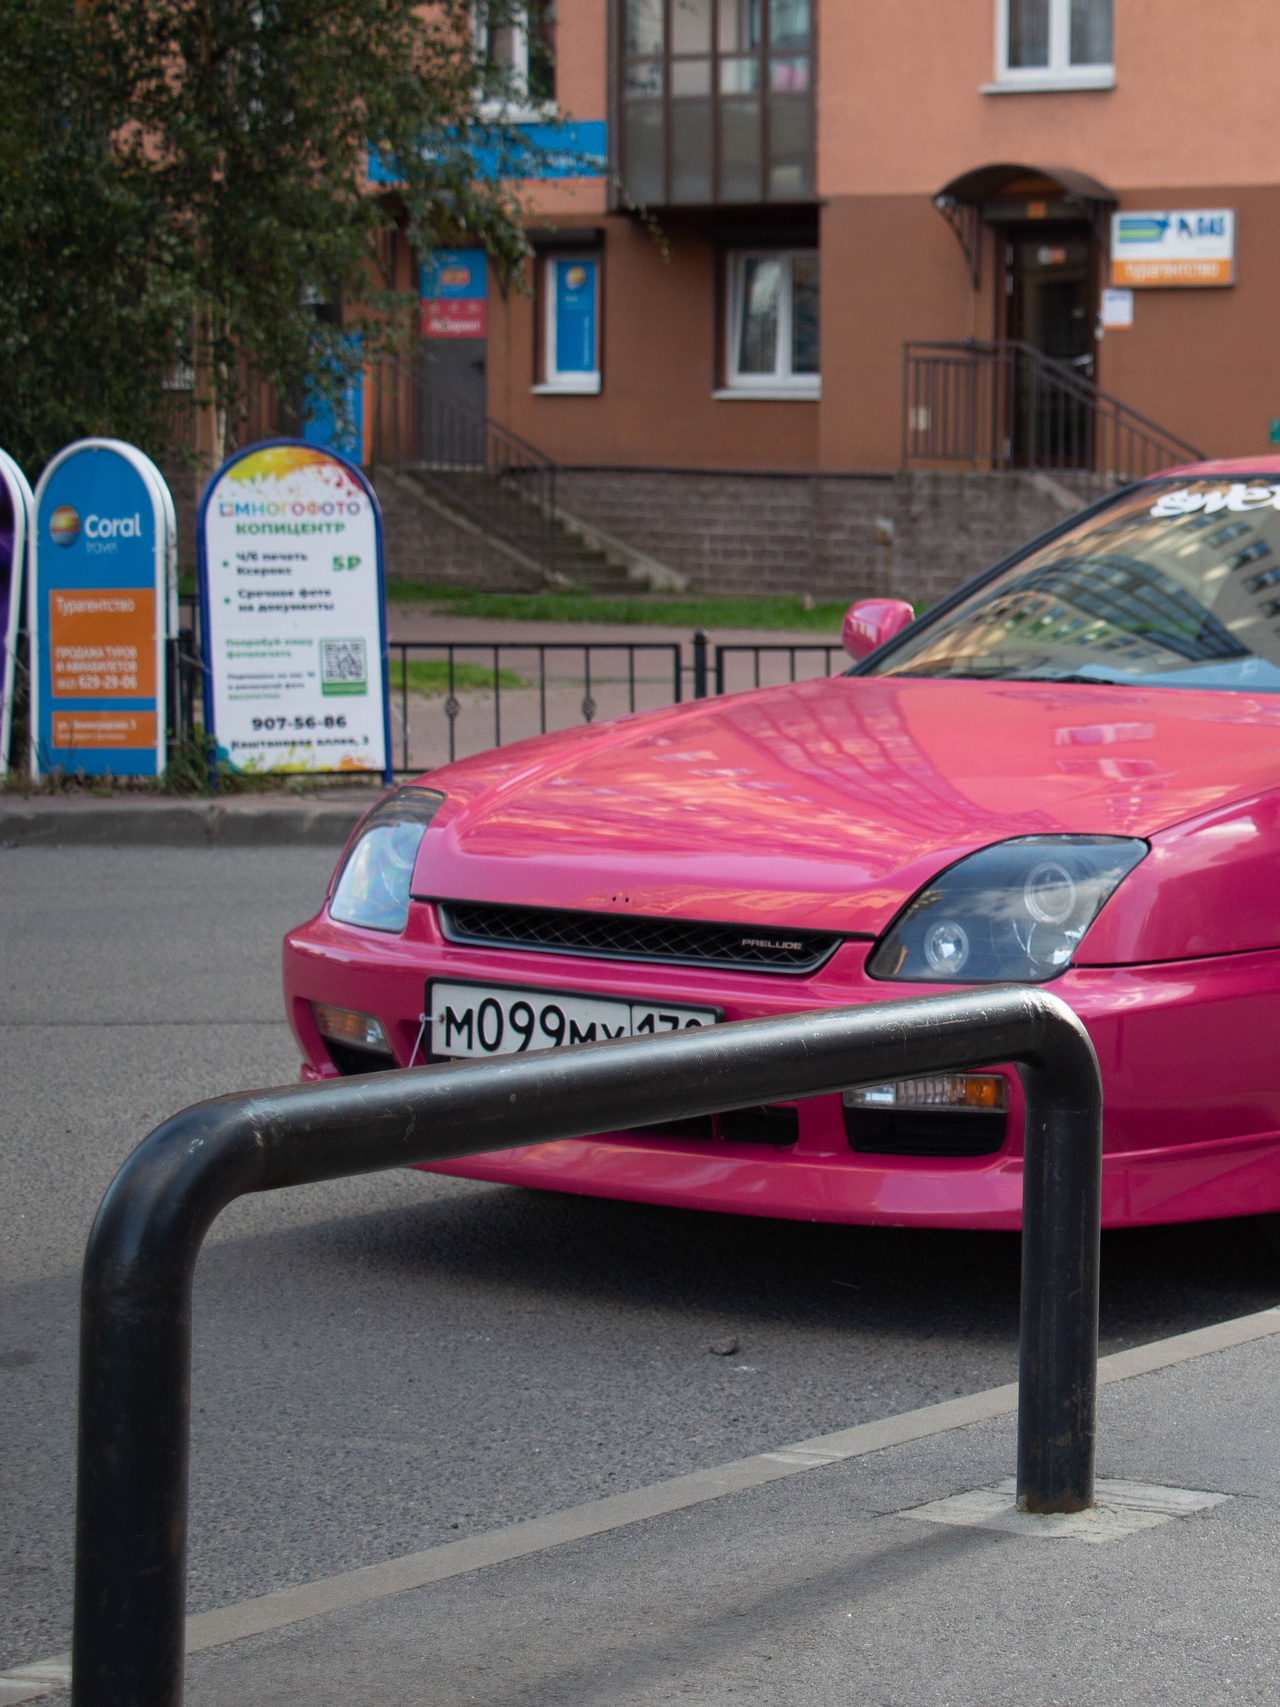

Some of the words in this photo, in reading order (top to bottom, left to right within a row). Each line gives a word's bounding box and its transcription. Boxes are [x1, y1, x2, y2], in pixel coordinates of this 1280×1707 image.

[235, 501, 361, 516] МНОГОФОТО
[84, 513, 142, 539] Coral
[235, 522, 345, 536] КОПИЦЕНТР
[57, 596, 136, 615] Турагентство
[252, 715, 346, 731] 907-56-86
[741, 938, 803, 951] PRELUDE
